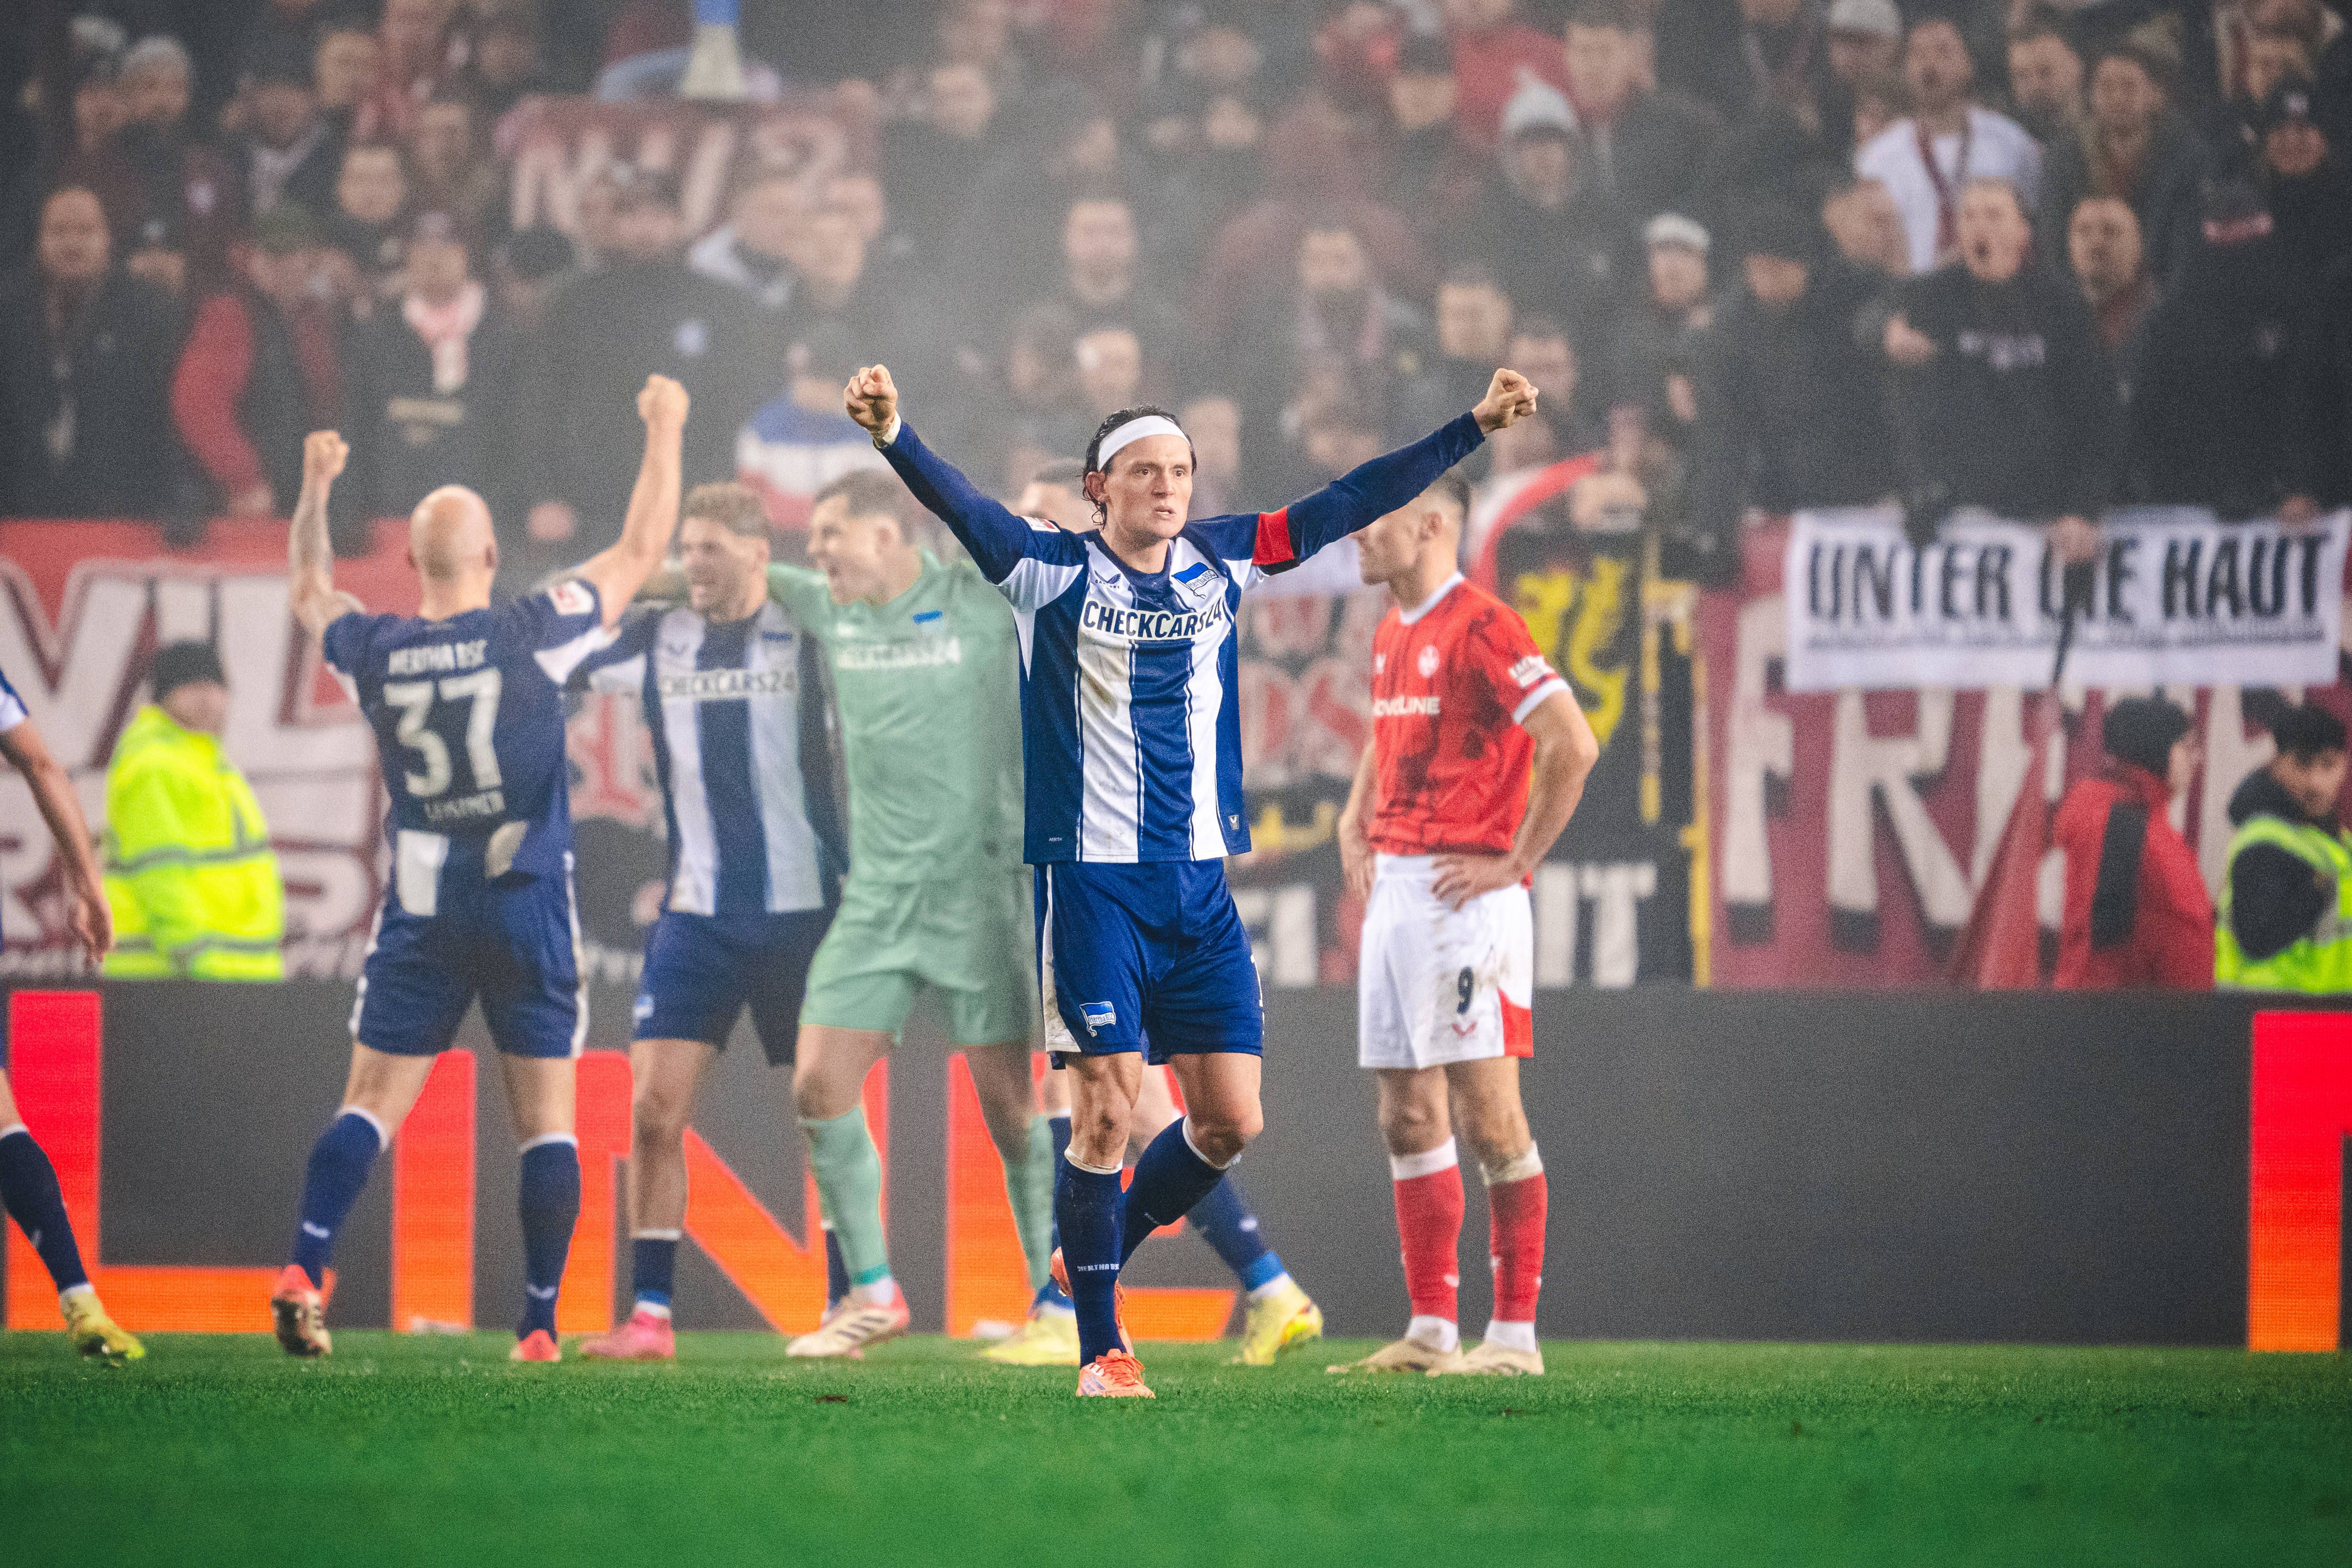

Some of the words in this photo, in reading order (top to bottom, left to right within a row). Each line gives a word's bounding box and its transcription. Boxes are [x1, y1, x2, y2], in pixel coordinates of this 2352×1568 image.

[1807, 537, 2014, 621] UNTER
[2161, 532, 2332, 622] HAUT
[1082, 597, 1222, 639] CHECKCARS24
[383, 667, 503, 797] 37
[1457, 966, 1474, 1014] 9
[1077, 1263, 1109, 1272] HERTHA
